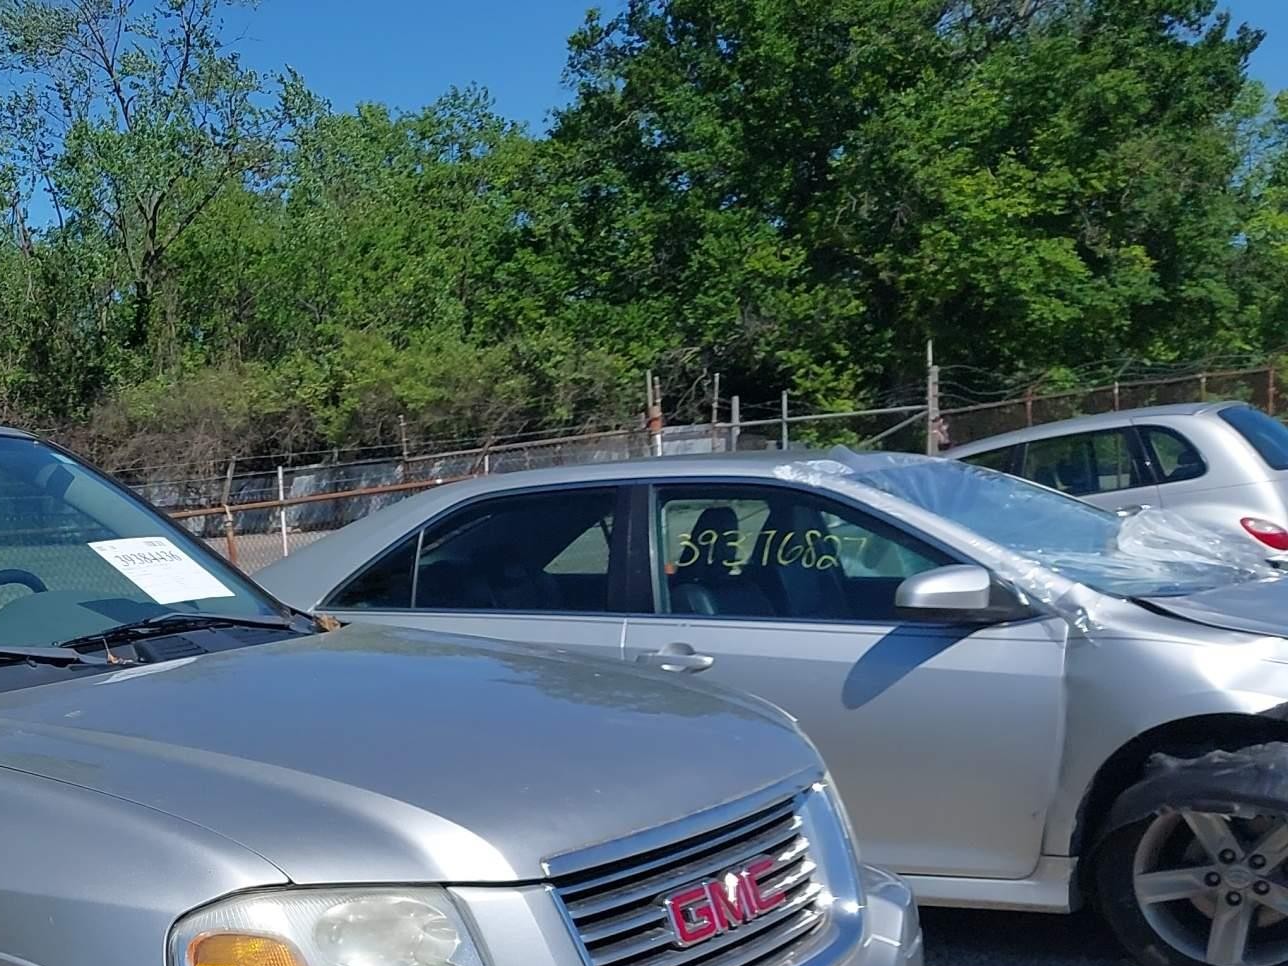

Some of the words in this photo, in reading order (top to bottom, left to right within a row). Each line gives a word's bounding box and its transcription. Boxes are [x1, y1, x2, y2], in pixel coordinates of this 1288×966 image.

[115, 551, 182, 567] 39384436
[675, 529, 866, 571] 39376827
[666, 858, 787, 947] GMC
